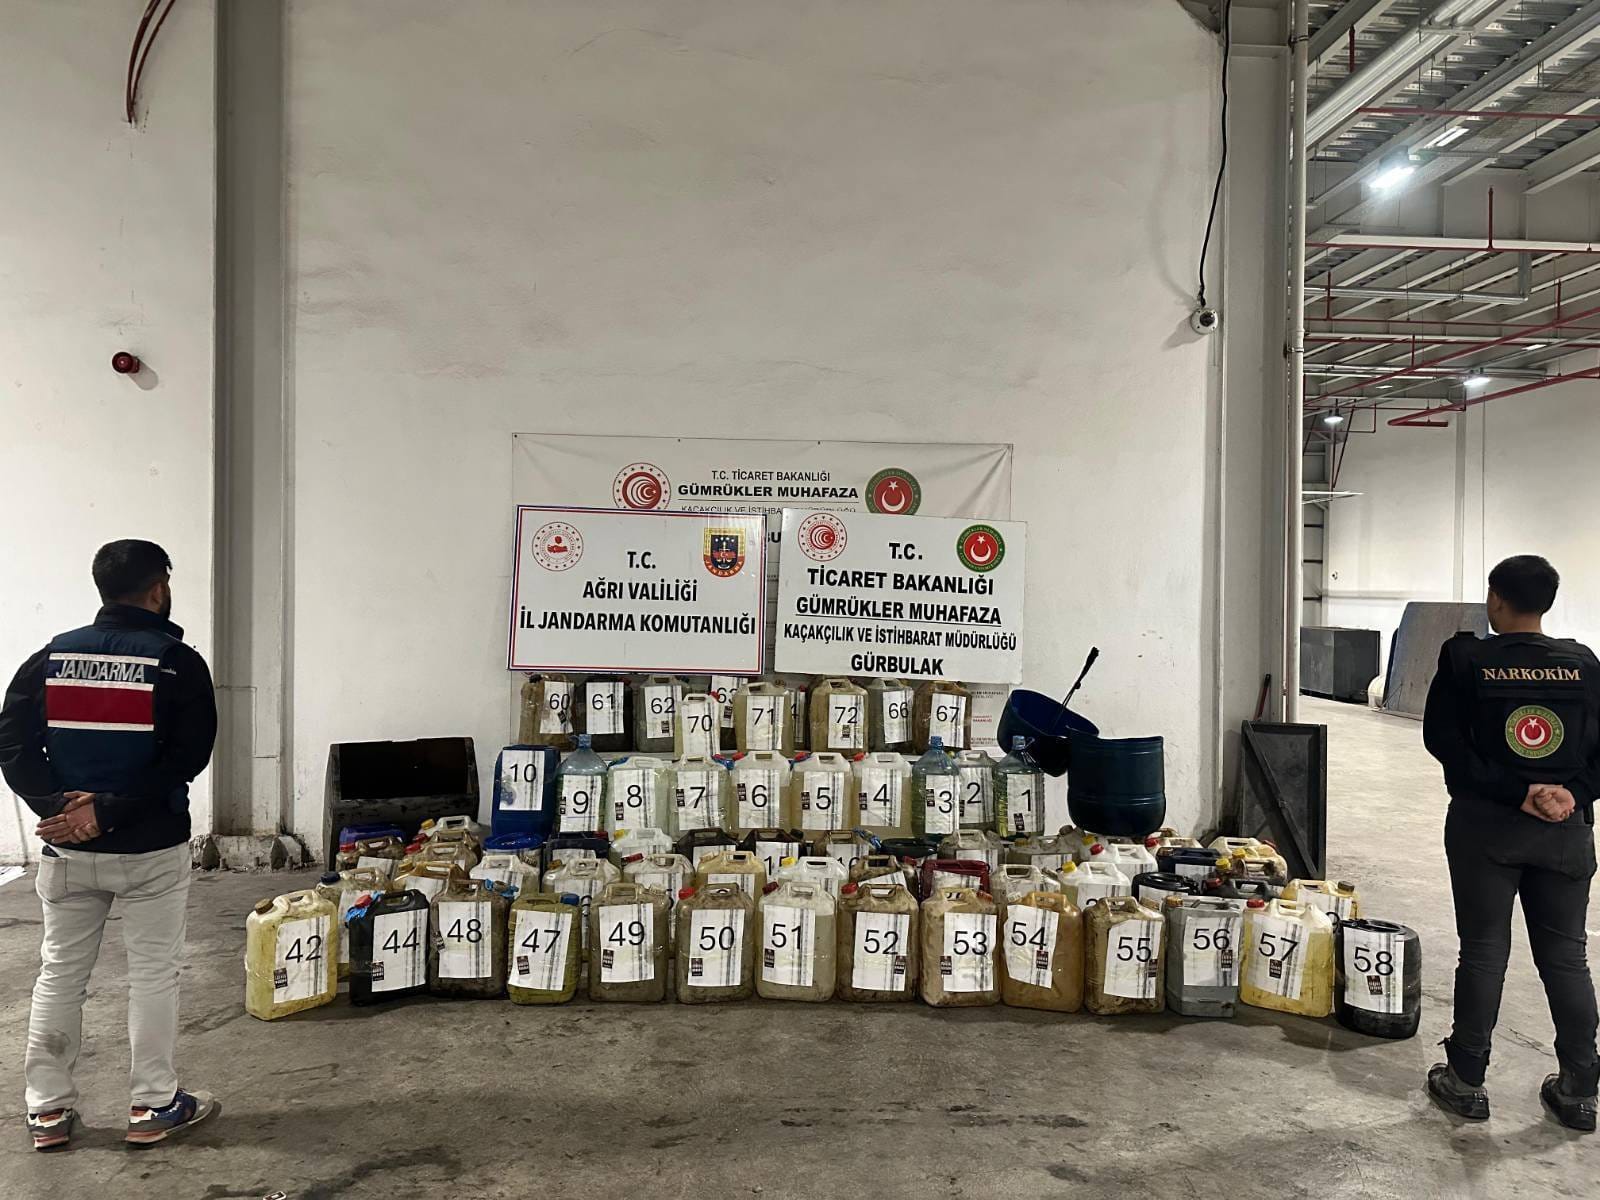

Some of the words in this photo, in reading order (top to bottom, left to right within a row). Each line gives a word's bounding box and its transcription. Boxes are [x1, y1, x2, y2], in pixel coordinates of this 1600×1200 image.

[712, 470, 728, 480] T.C.
[732, 469, 774, 481] TİCARET
[777, 470, 830, 482] BAKANLIĞI
[678, 483, 772, 497] GÜMRÜKLER
[777, 486, 858, 498] MUHAFAZA
[627, 551, 656, 569] T.C.
[888, 542, 922, 560] T.C.
[583, 577, 623, 600] AĞRI
[628, 578, 698, 602] VALİLİĞİ
[807, 564, 887, 588] TİCARET
[893, 574, 994, 595] BAKANLIĞI
[520, 606, 534, 628] İL
[538, 611, 636, 632] JANDARMA
[640, 612, 756, 634] KOMUTANLIĞI
[796, 594, 904, 619] GÜMRÜKLER
[910, 604, 1001, 624] MUHAFAZA
[784, 623, 854, 644] KAÇAKÇILIK
[857, 628, 872, 642] VE
[875, 624, 942, 647] İSTİHBARAT
[946, 630, 1017, 650] MÜDÜRLÜĞÜ
[56, 660, 144, 682] JANDARMA
[851, 651, 944, 676] GÜRBULAK
[1482, 666, 1581, 680] NARKOKİM
[550, 693, 570, 710] 60
[592, 694, 614, 710] 61
[650, 696, 676, 714] 62
[888, 702, 910, 720] 66
[936, 705, 960, 722] 67
[687, 714, 712, 733] 70
[752, 708, 774, 726] 71
[834, 706, 858, 724] 72
[510, 763, 537, 783] 10
[572, 790, 589, 814] 9
[627, 784, 642, 808] 8
[689, 786, 706, 809] 7
[752, 784, 768, 808] 6
[816, 786, 832, 810] 5
[873, 784, 890, 806] 4
[938, 790, 953, 814] 3
[966, 782, 982, 805] 2
[1021, 789, 1031, 812] 1
[382, 928, 420, 954] 44
[446, 918, 482, 944] 48
[522, 928, 560, 954] 47
[608, 921, 645, 946] 49
[700, 926, 735, 951] 50
[771, 923, 802, 950] 51
[864, 929, 898, 955] 52
[953, 930, 988, 956] 53
[1011, 922, 1046, 950] 54
[1193, 928, 1230, 950] 56
[285, 934, 322, 964] 42
[1116, 936, 1152, 963] 55
[1258, 932, 1298, 962] 57
[1354, 946, 1394, 976] 58
